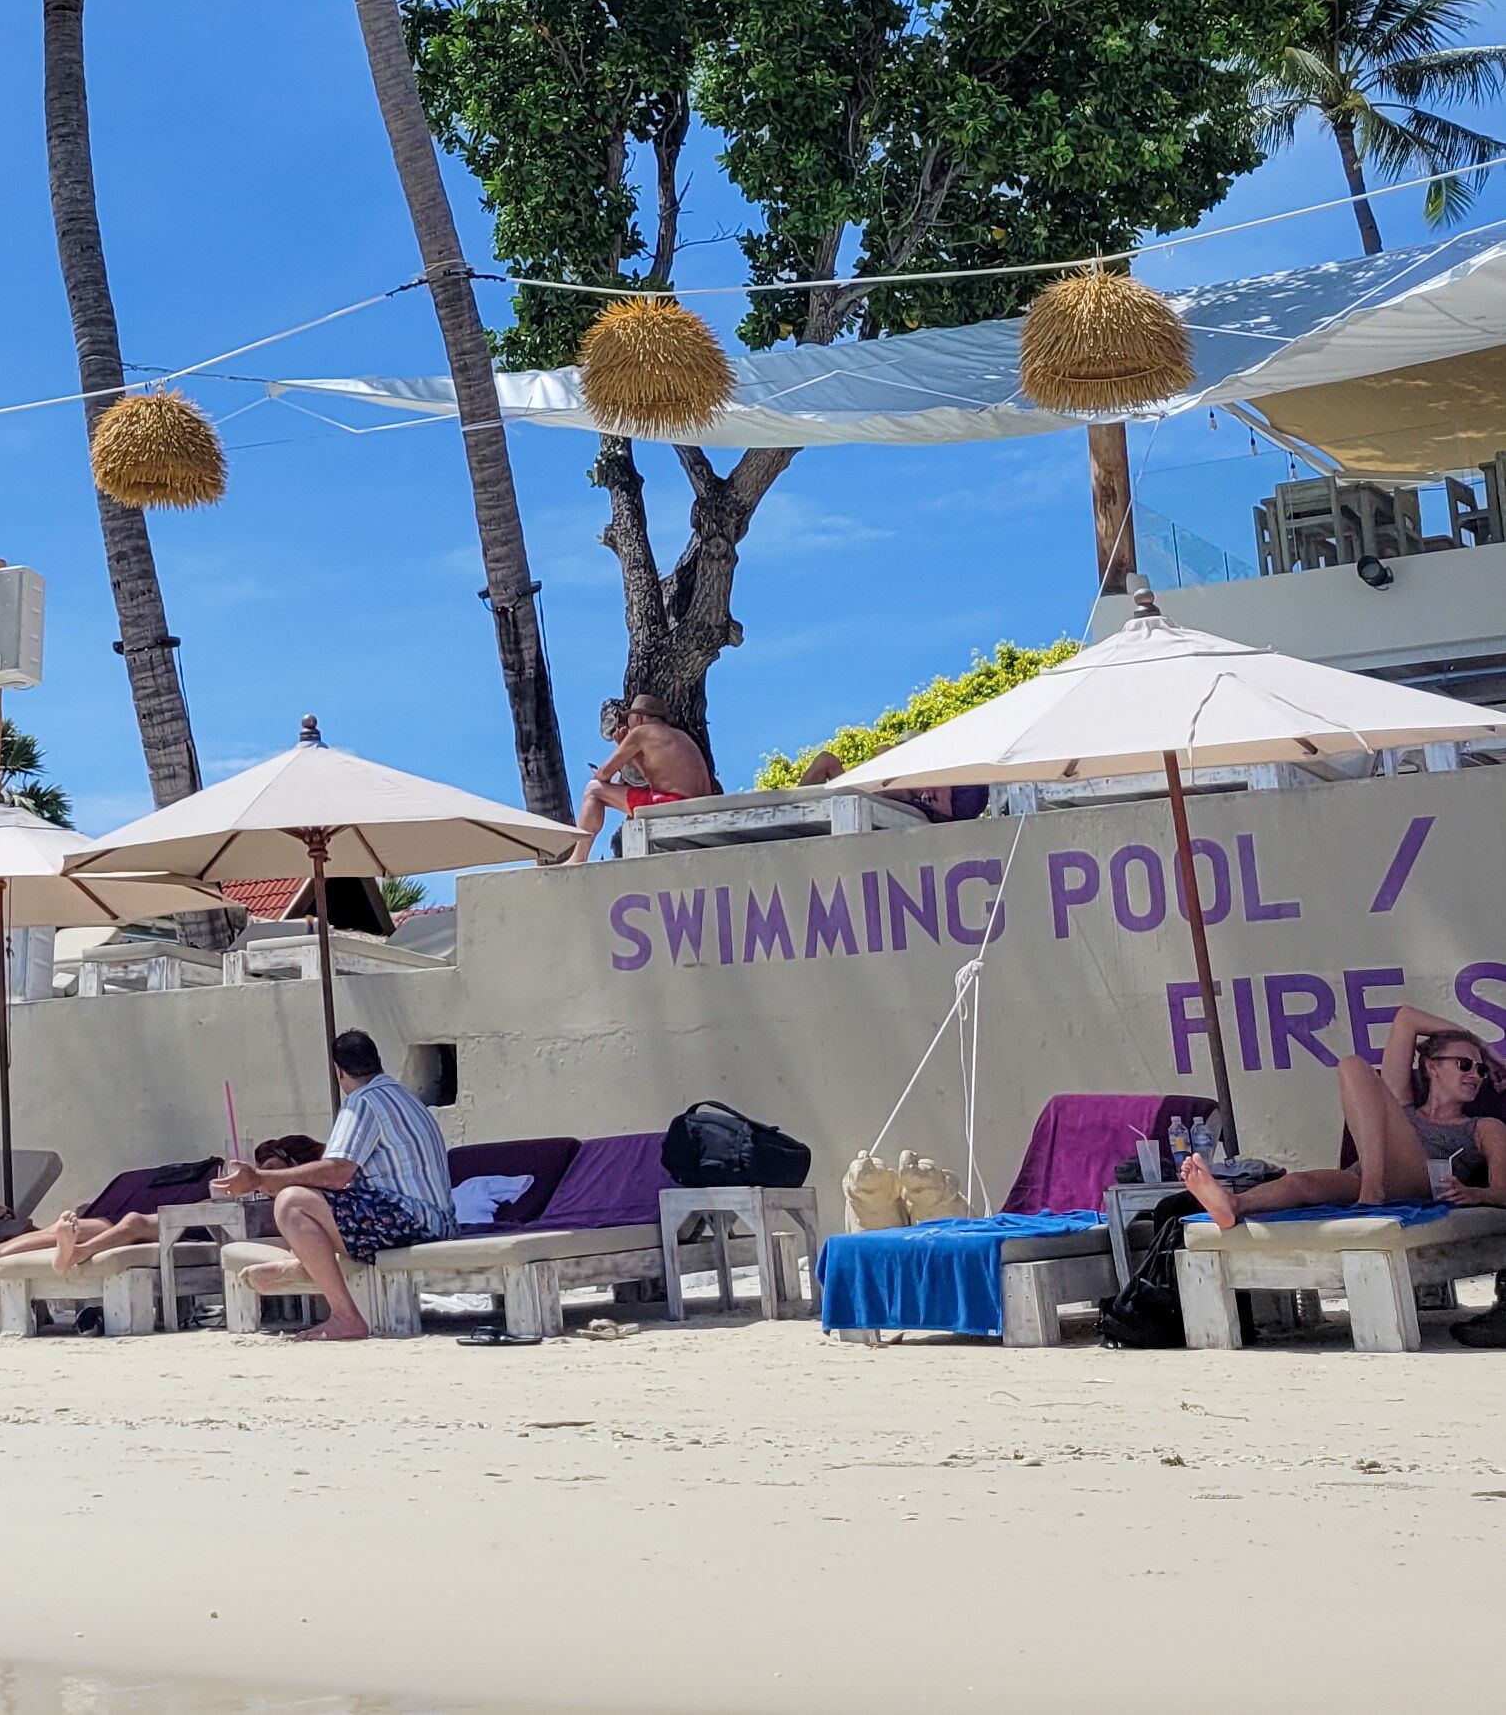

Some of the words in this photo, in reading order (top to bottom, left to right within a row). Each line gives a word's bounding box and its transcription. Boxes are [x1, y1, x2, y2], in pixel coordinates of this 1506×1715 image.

[609, 859, 1006, 971] SWIMMING
[1047, 833, 1301, 939] POOL
[1368, 815, 1436, 913] /
[1166, 967, 1405, 1074] FIRE
